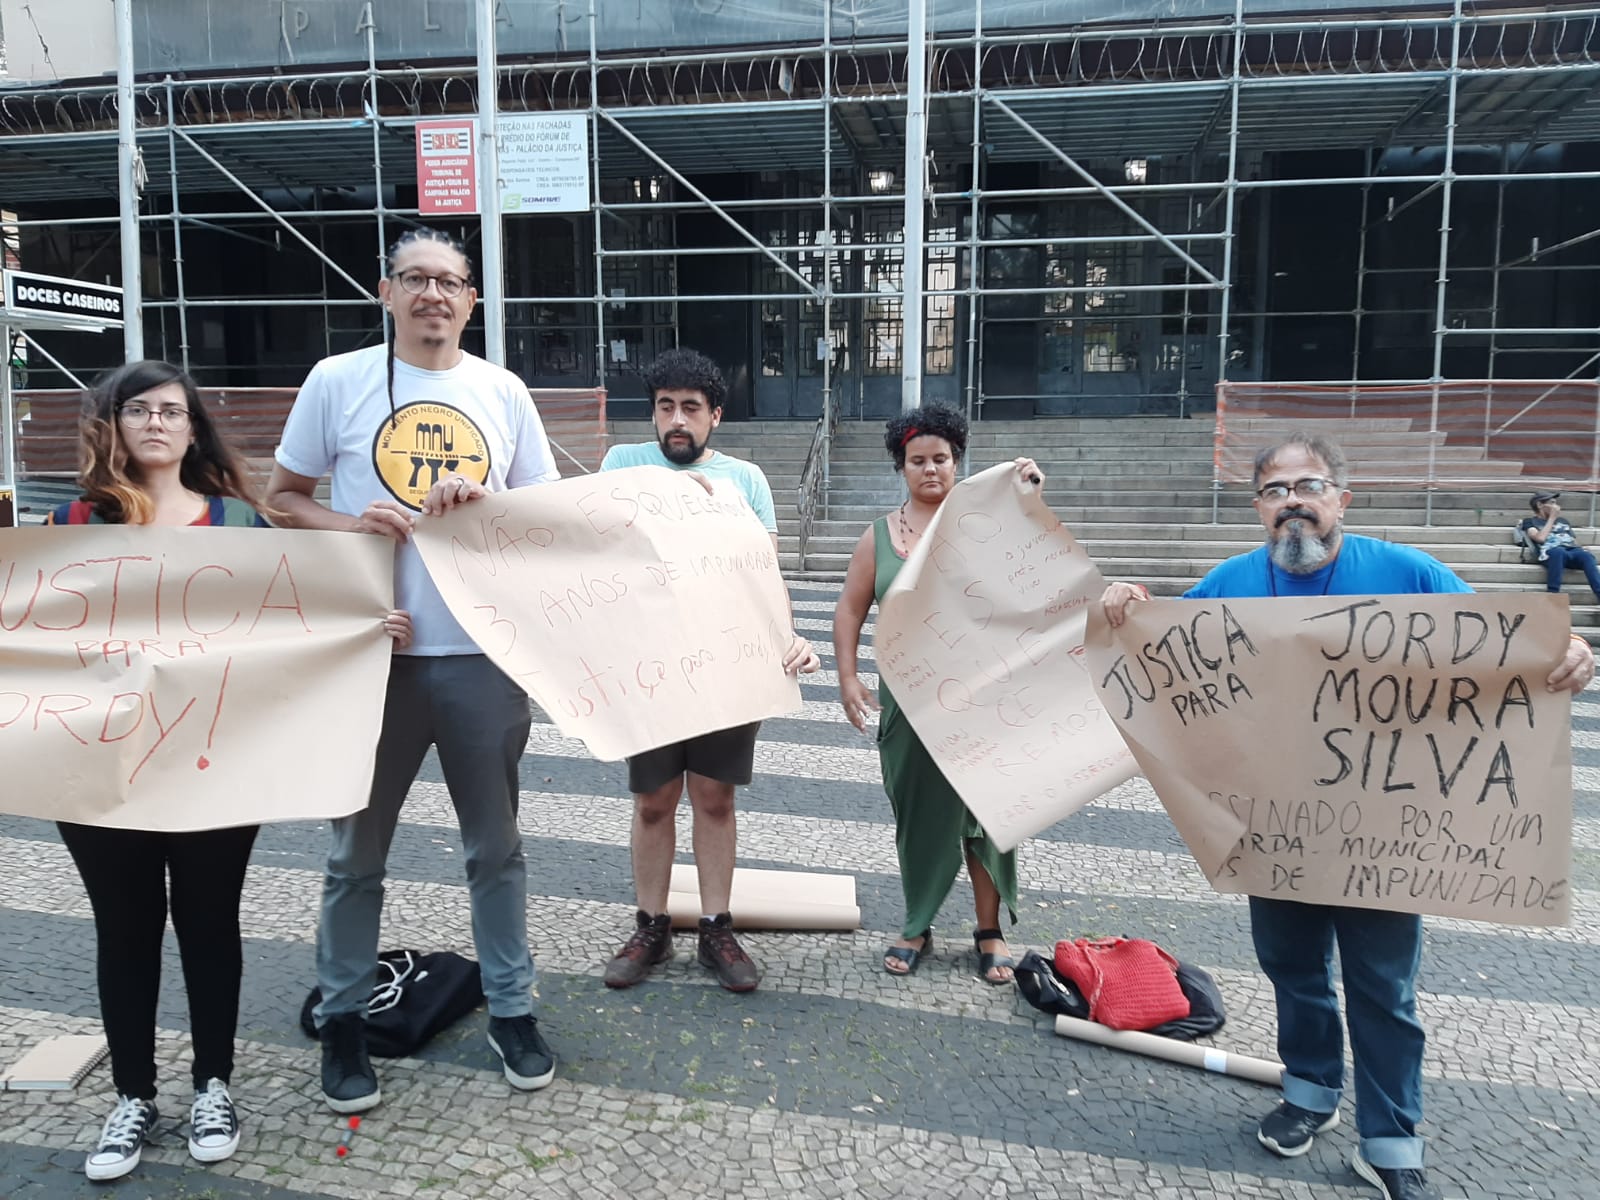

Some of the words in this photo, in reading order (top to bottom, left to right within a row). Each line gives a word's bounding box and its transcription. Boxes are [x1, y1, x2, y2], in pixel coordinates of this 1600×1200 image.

[516, 143, 543, 152] PALÁCIO
[544, 144, 554, 152] DA
[556, 143, 583, 152] JUSTIÇA
[537, 120, 572, 129] FACHADAS
[17, 285, 61, 305] DOCES
[63, 291, 120, 313] CASEIROS
[420, 405, 453, 418] NEGRO
[454, 414, 485, 457] UNIFICADO
[451, 509, 554, 585] NÃO
[0, 553, 312, 640] USTIÇA
[473, 605, 518, 656] 3
[538, 573, 628, 628] ANOS
[646, 560, 681, 588] DE
[75, 639, 208, 669] PARA
[1302, 599, 1526, 670] JORDY
[1102, 604, 1261, 721] JUSTIÇA
[0, 656, 232, 785] ORDY!
[1170, 672, 1254, 727] PARA
[1312, 668, 1535, 729] MOURA
[1315, 727, 1520, 809] SILVA
[1339, 835, 1507, 871] MUNICIPAL
[1400, 804, 1456, 845] POR
[1490, 812, 1545, 849] UM
[1272, 863, 1306, 893] DE
[1343, 864, 1569, 911] IMPUNIDADE
